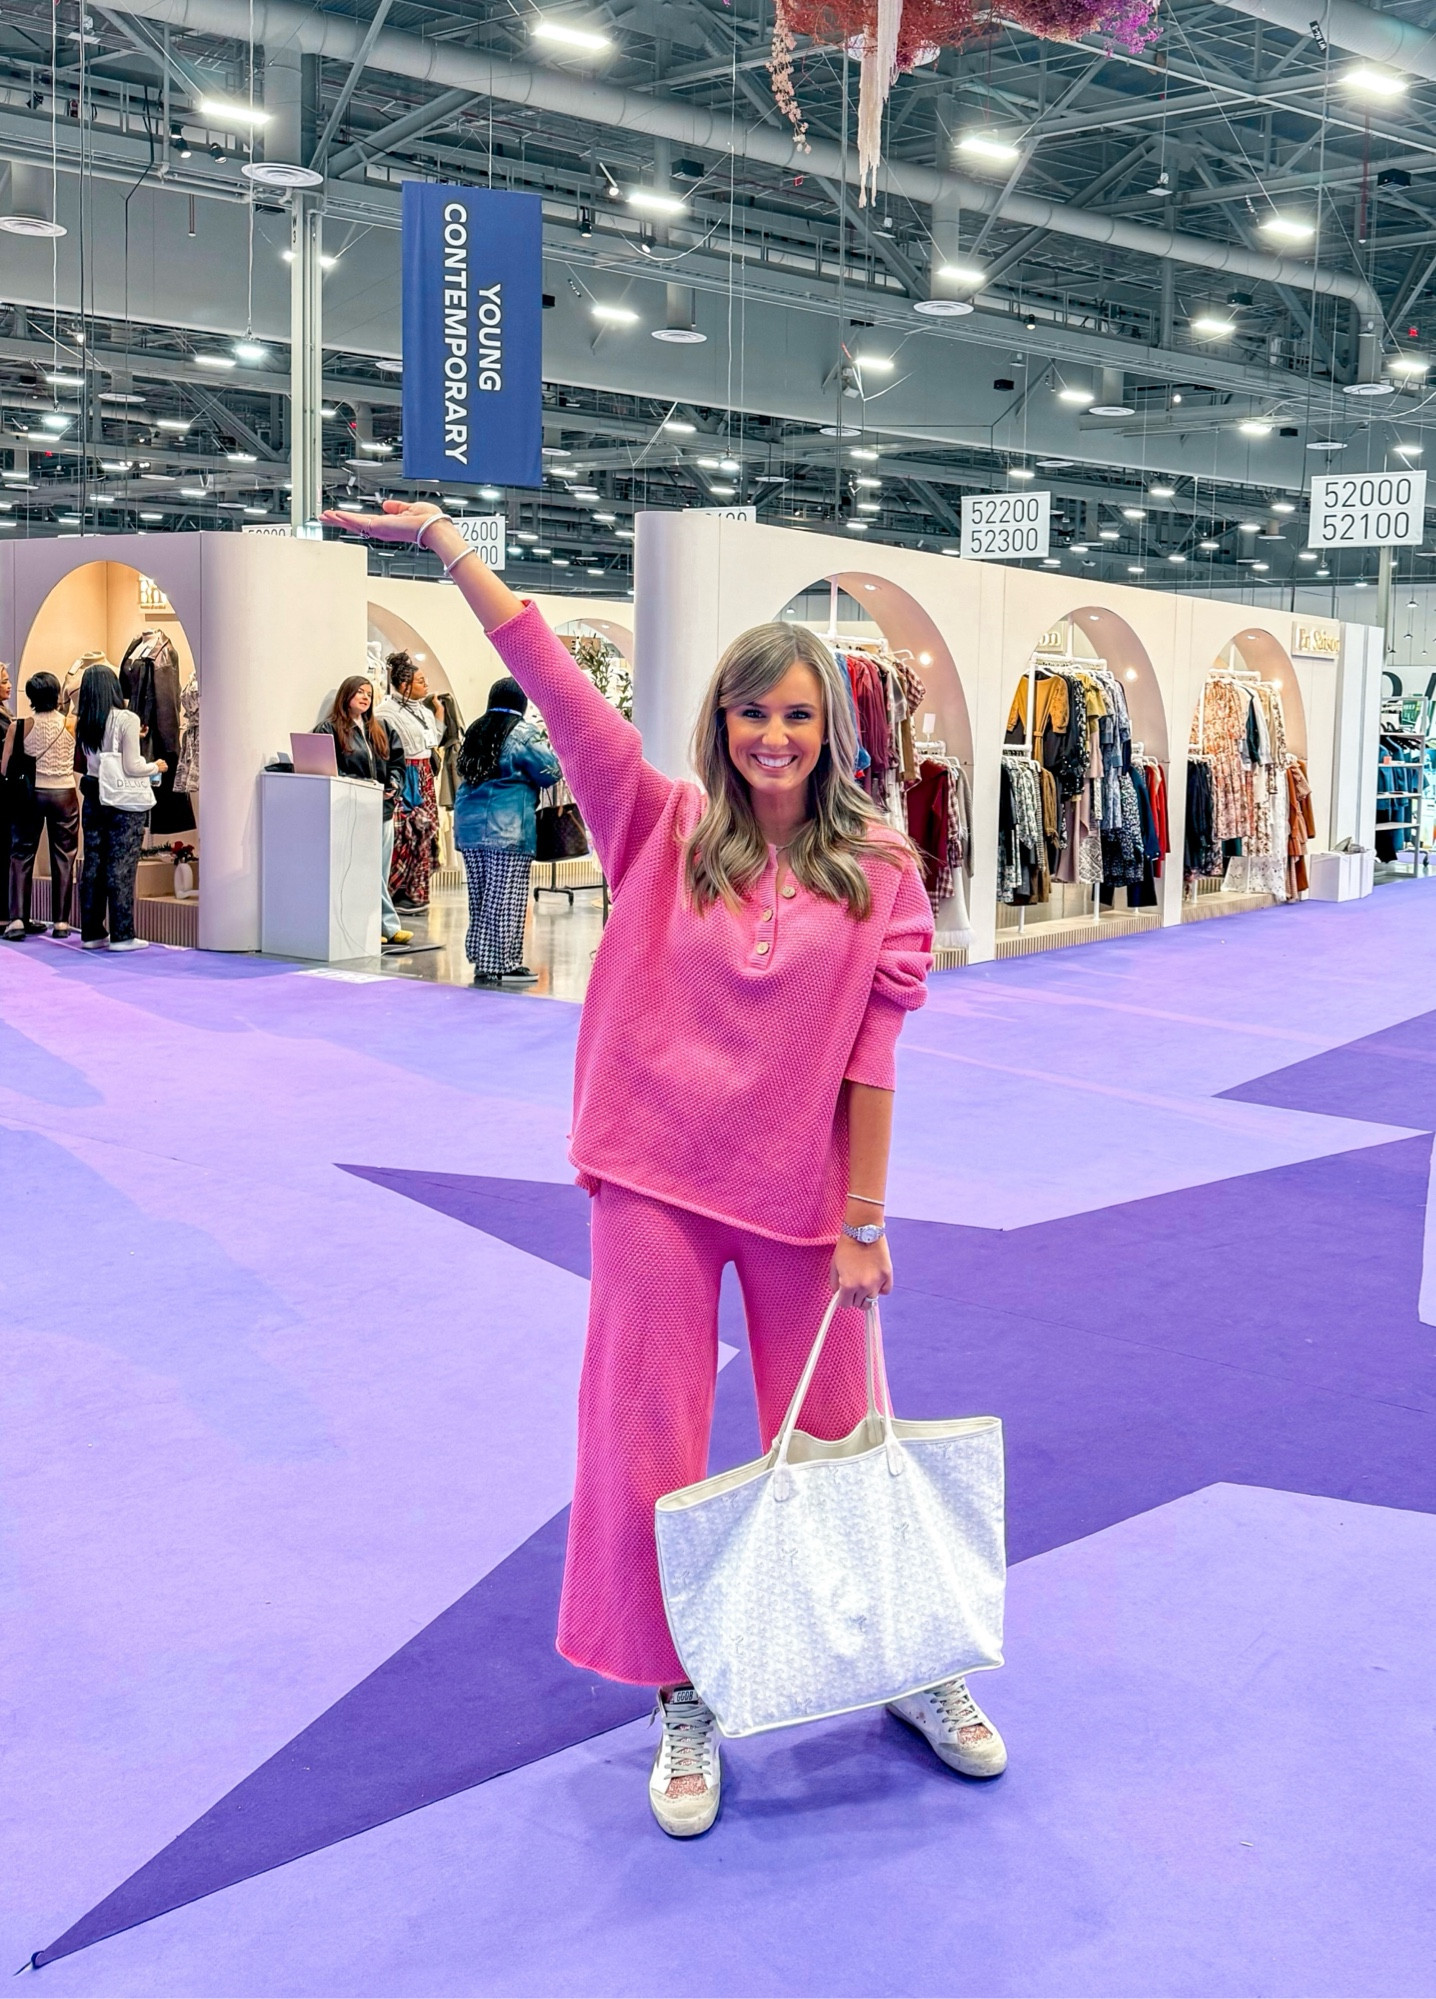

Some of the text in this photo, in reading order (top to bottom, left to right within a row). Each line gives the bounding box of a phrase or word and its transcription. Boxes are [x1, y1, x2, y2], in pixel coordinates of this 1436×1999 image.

[444, 203, 468, 465] CONTEMPORARY
[478, 283, 501, 391] YOUNG
[1324, 478, 1412, 508] 52000
[971, 498, 1039, 525] 52200
[453, 521, 498, 541] 2600
[971, 528, 1038, 553] 52300
[1322, 512, 1410, 541] 52100
